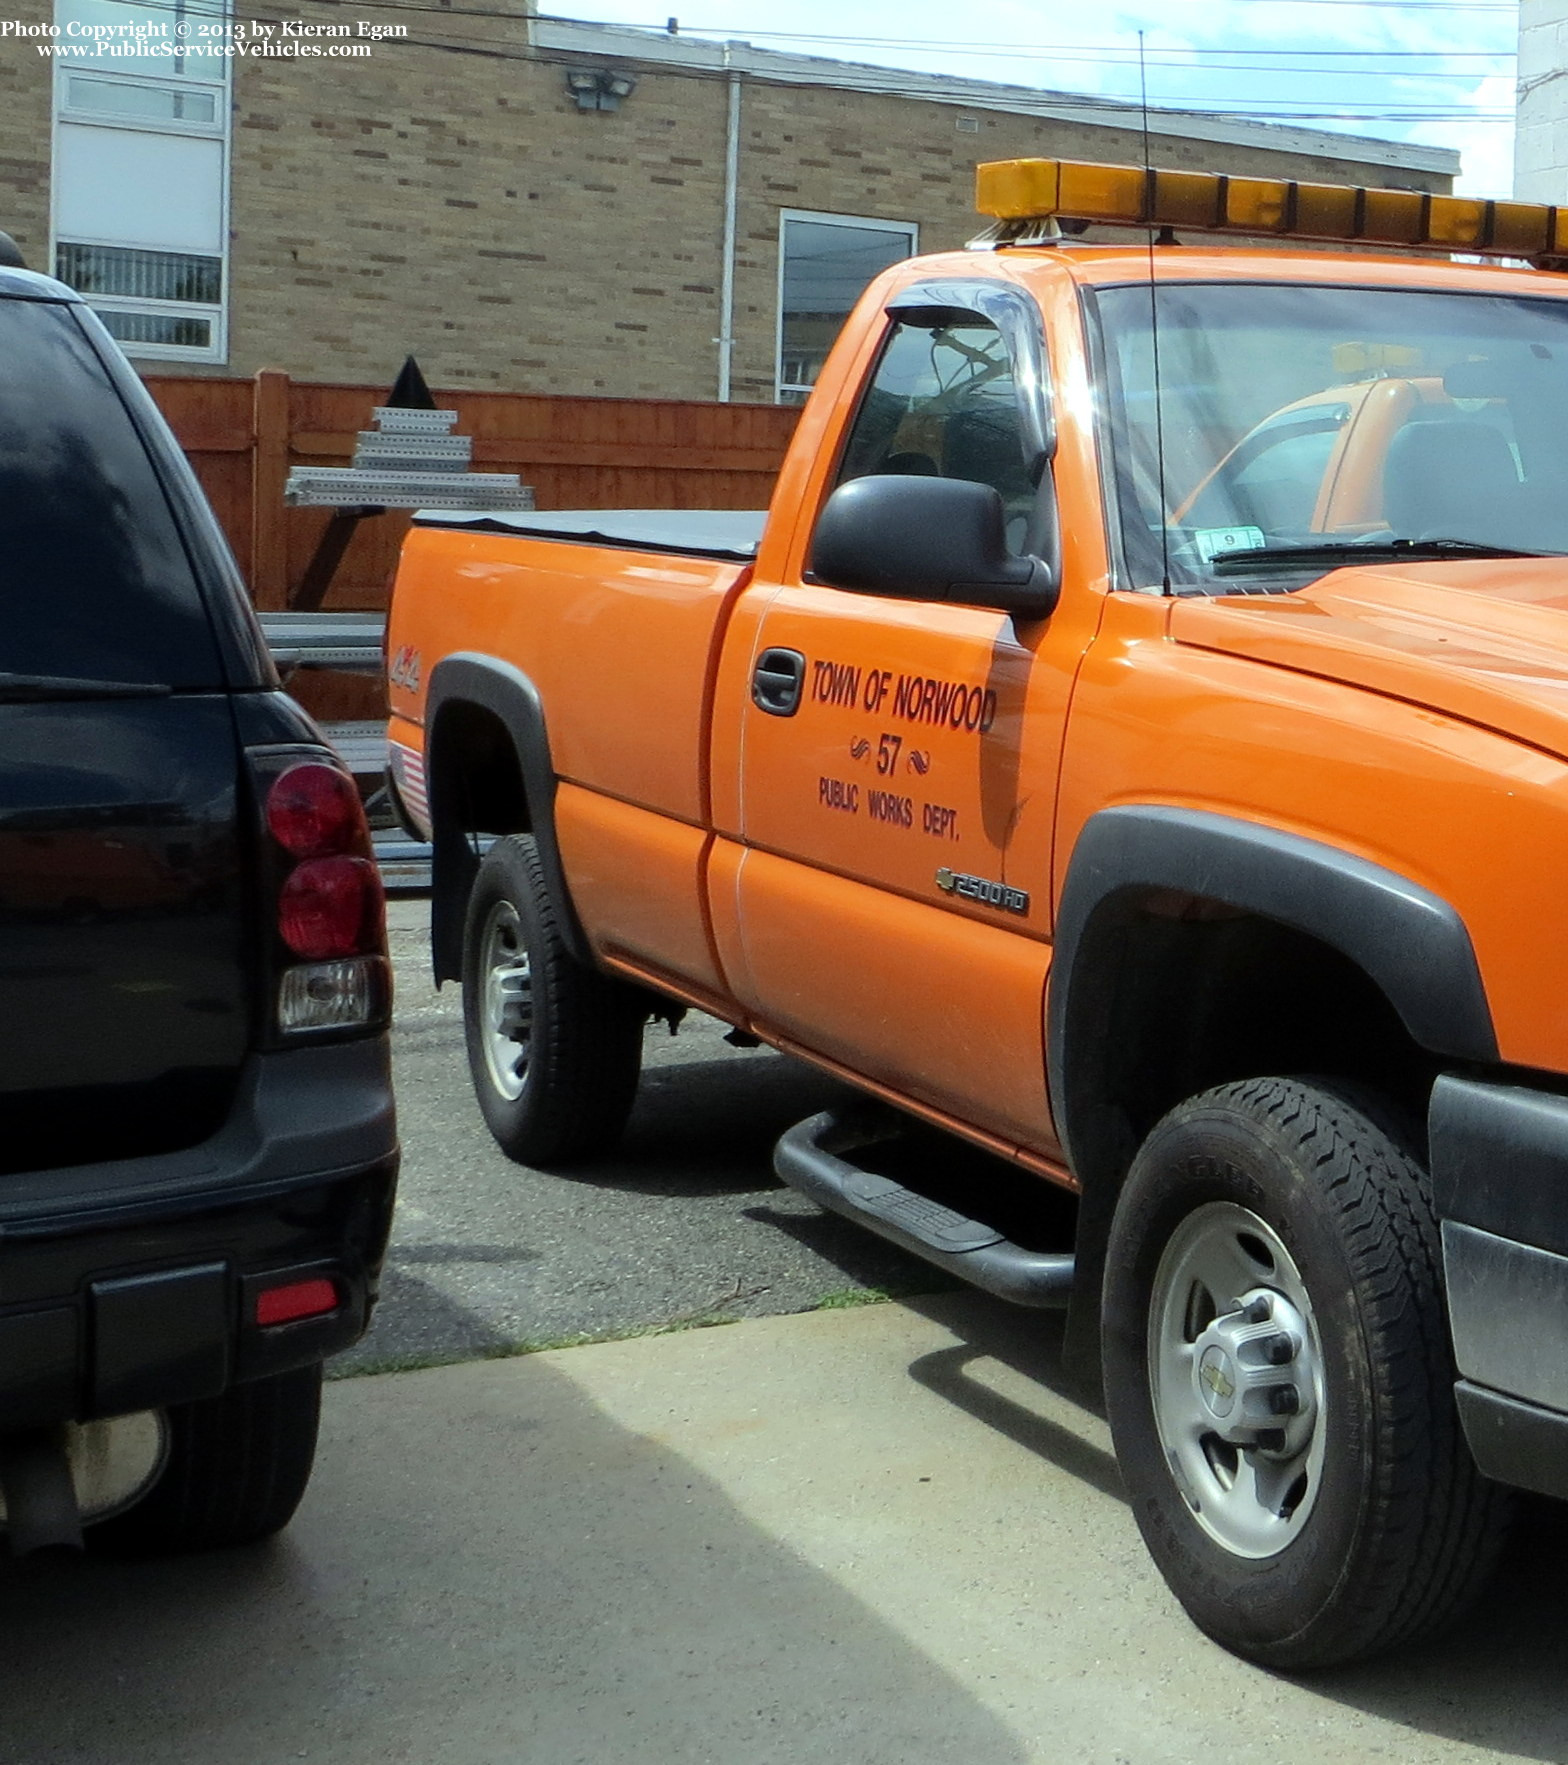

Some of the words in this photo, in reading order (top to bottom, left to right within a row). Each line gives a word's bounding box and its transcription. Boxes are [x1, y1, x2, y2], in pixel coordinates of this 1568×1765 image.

[812, 660, 861, 710] TOWN
[864, 668, 892, 714] OF
[892, 675, 997, 735] NORWOOD
[877, 733, 902, 776] 57
[819, 776, 859, 813] PUBLIC
[868, 790, 913, 828] WORKS
[923, 802, 960, 841] DEPT.
